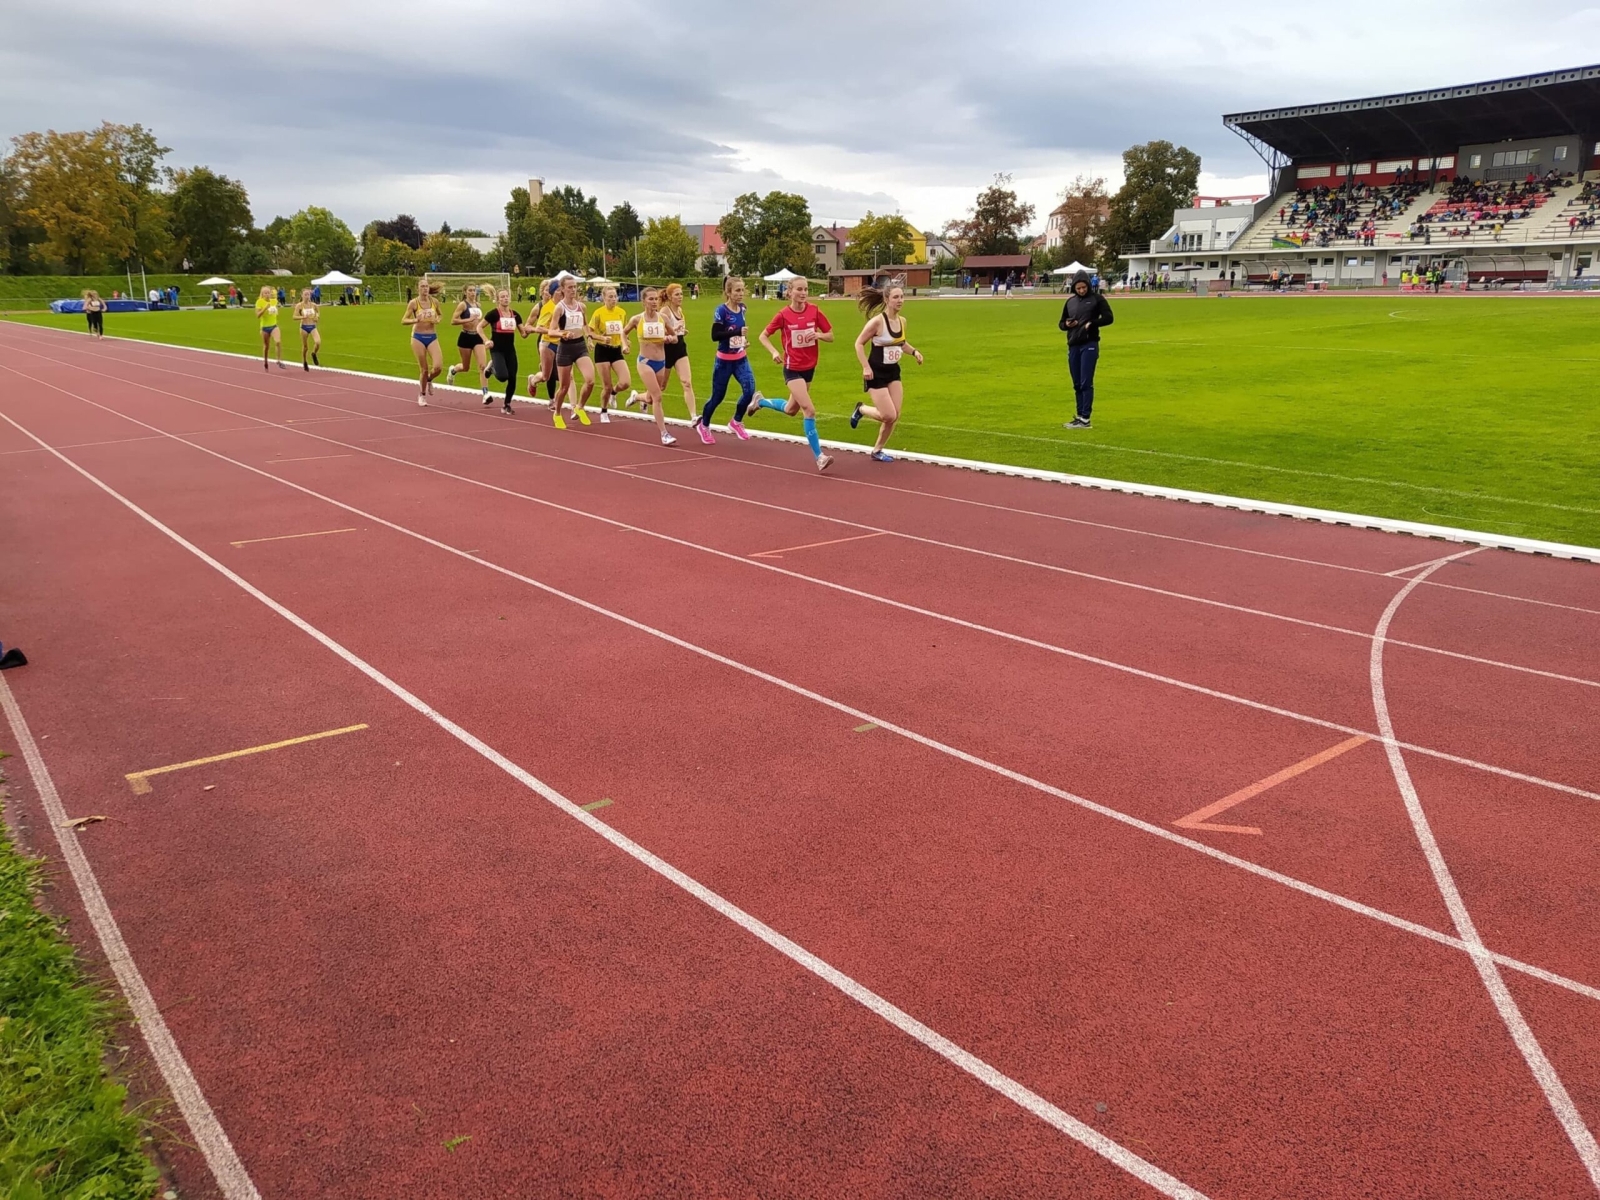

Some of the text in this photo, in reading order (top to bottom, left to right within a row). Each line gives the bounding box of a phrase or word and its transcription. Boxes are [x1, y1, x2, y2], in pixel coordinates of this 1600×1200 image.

[570, 315, 580, 324] 77
[609, 324, 620, 332] 93
[647, 326, 660, 335] 91
[888, 350, 900, 361] 86
